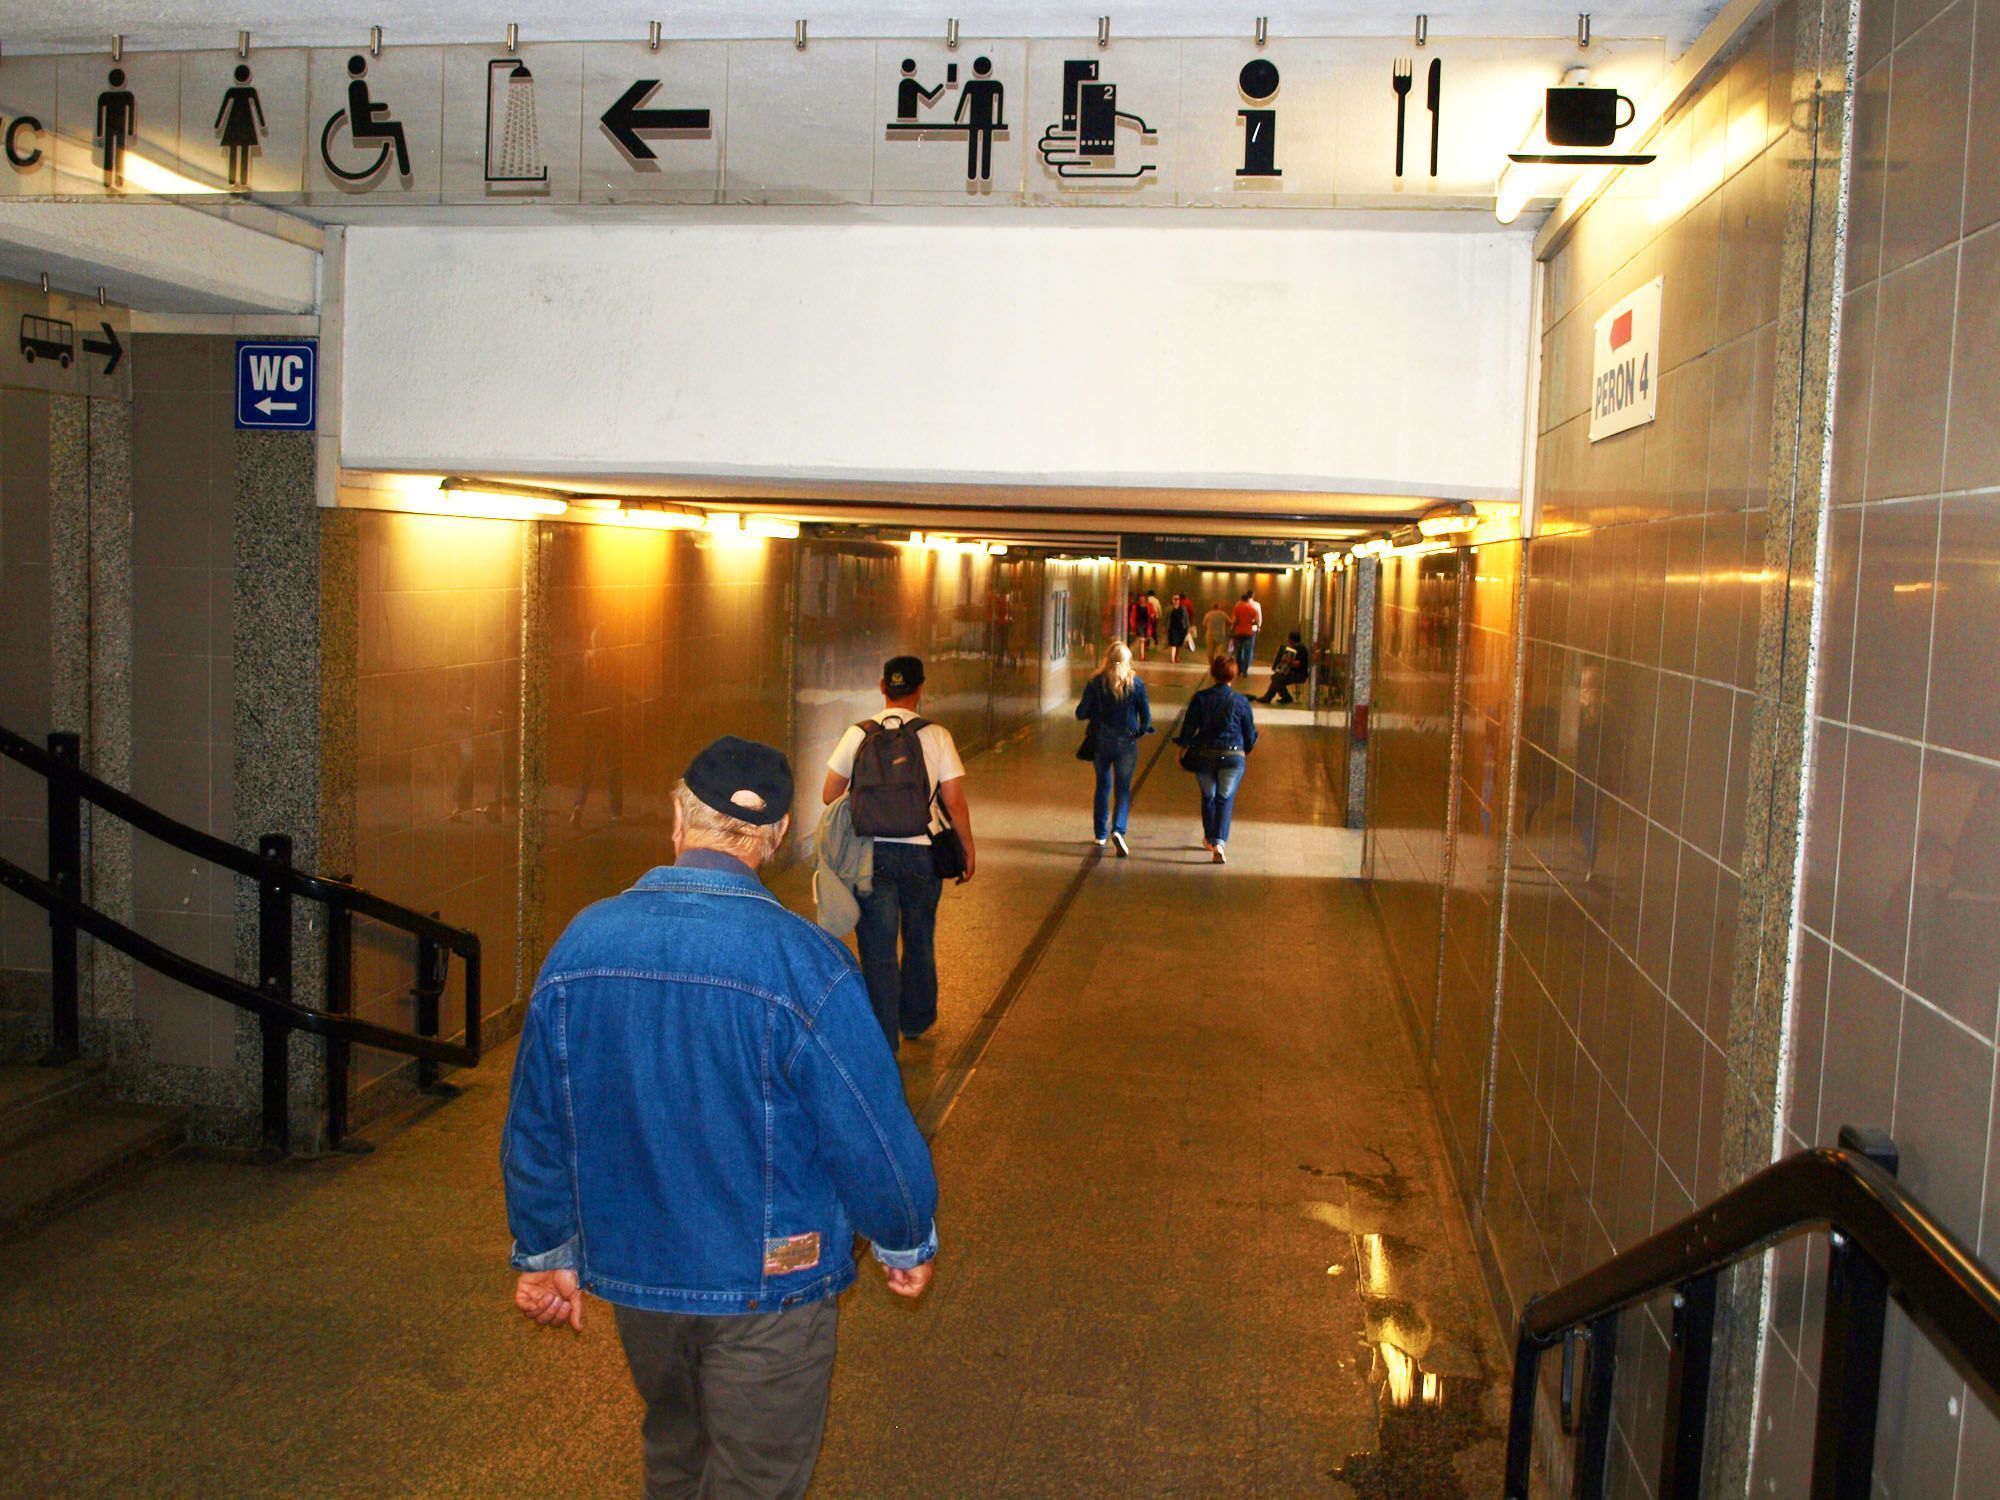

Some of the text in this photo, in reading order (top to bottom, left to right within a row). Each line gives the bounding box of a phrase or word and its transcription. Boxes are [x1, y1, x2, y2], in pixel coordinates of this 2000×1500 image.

[1089, 63, 1097, 77] 1
[1103, 85, 1114, 99] 2
[0, 116, 43, 166] C
[249, 354, 304, 392] WC
[1595, 352, 1649, 420] PERON 4
[1290, 543, 1301, 562] 1
